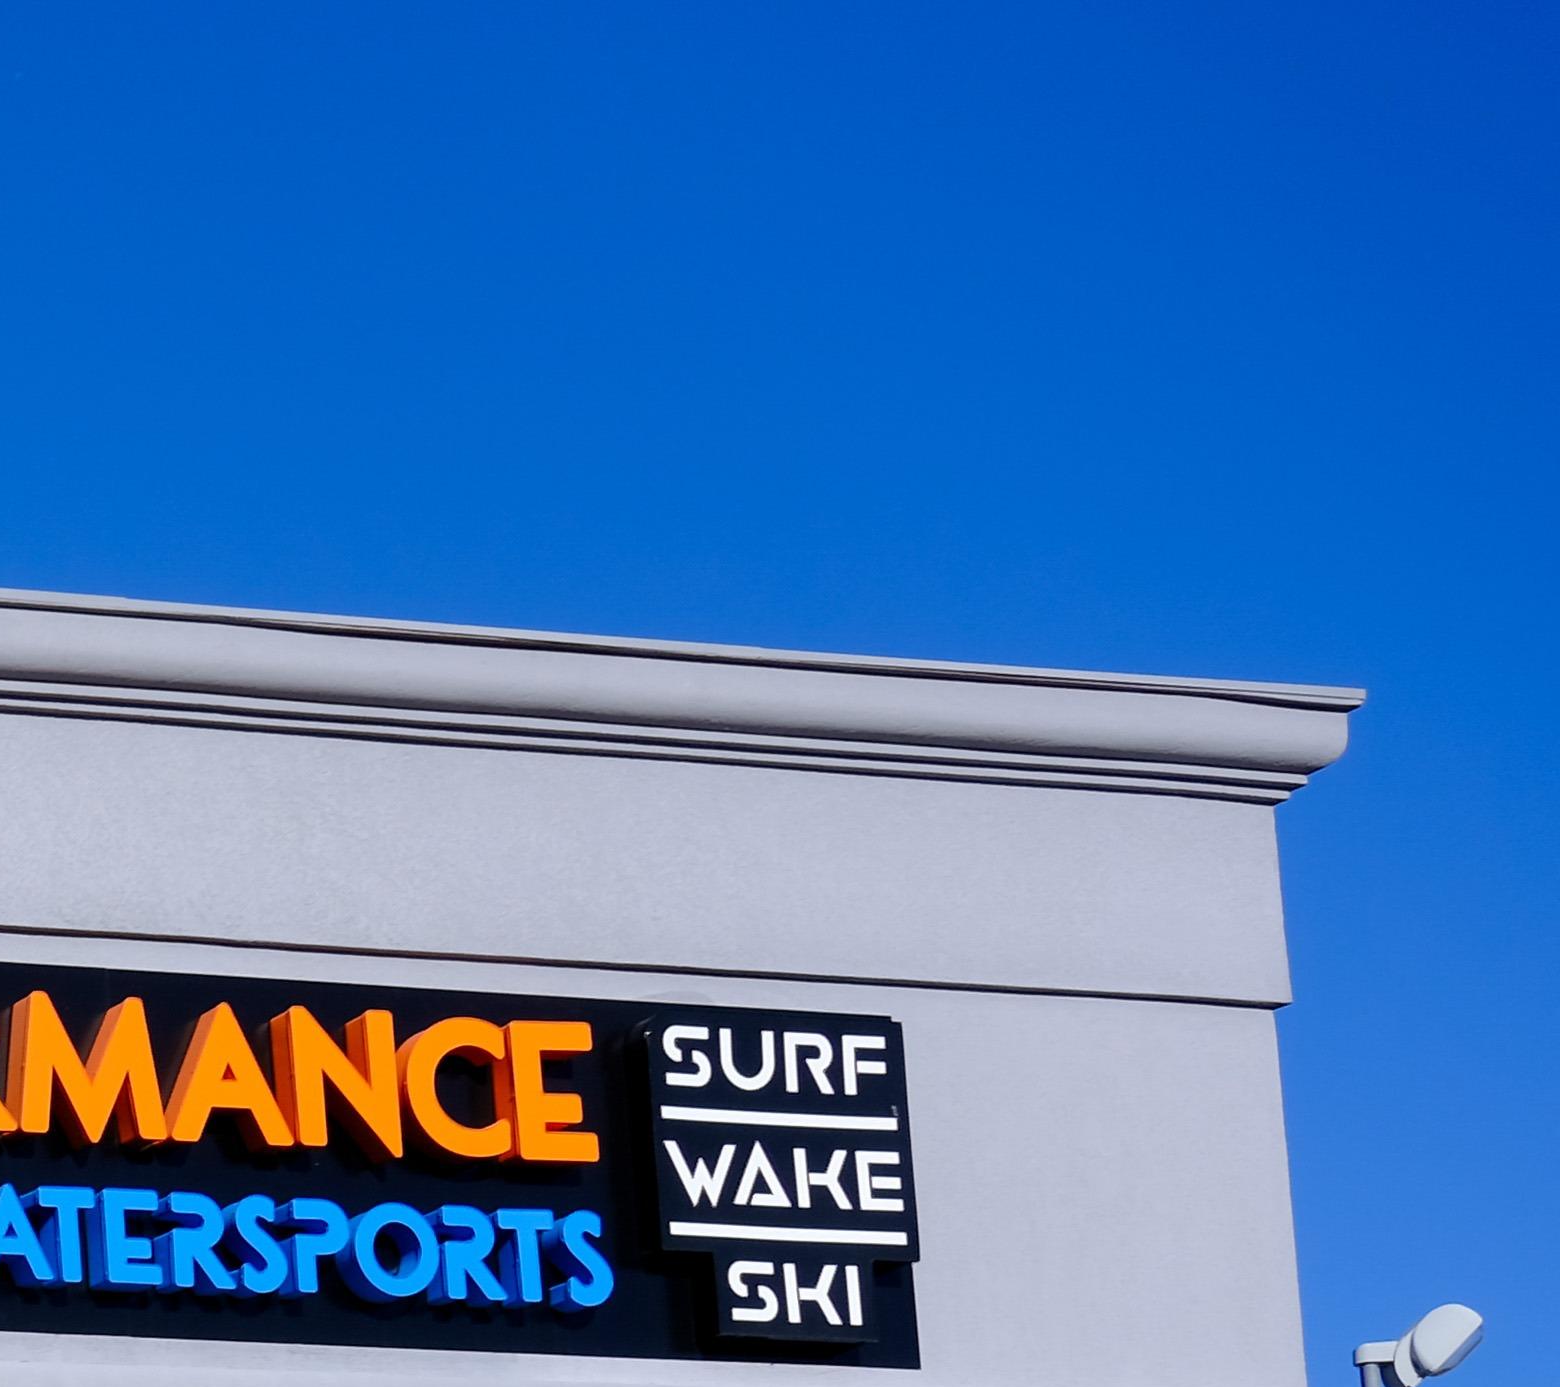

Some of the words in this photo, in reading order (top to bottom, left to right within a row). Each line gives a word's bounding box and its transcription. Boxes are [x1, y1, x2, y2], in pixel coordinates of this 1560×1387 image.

[662, 1023, 888, 1097] SURF
[673, 1141, 908, 1213] WAKE
[728, 1259, 865, 1328] SKI
